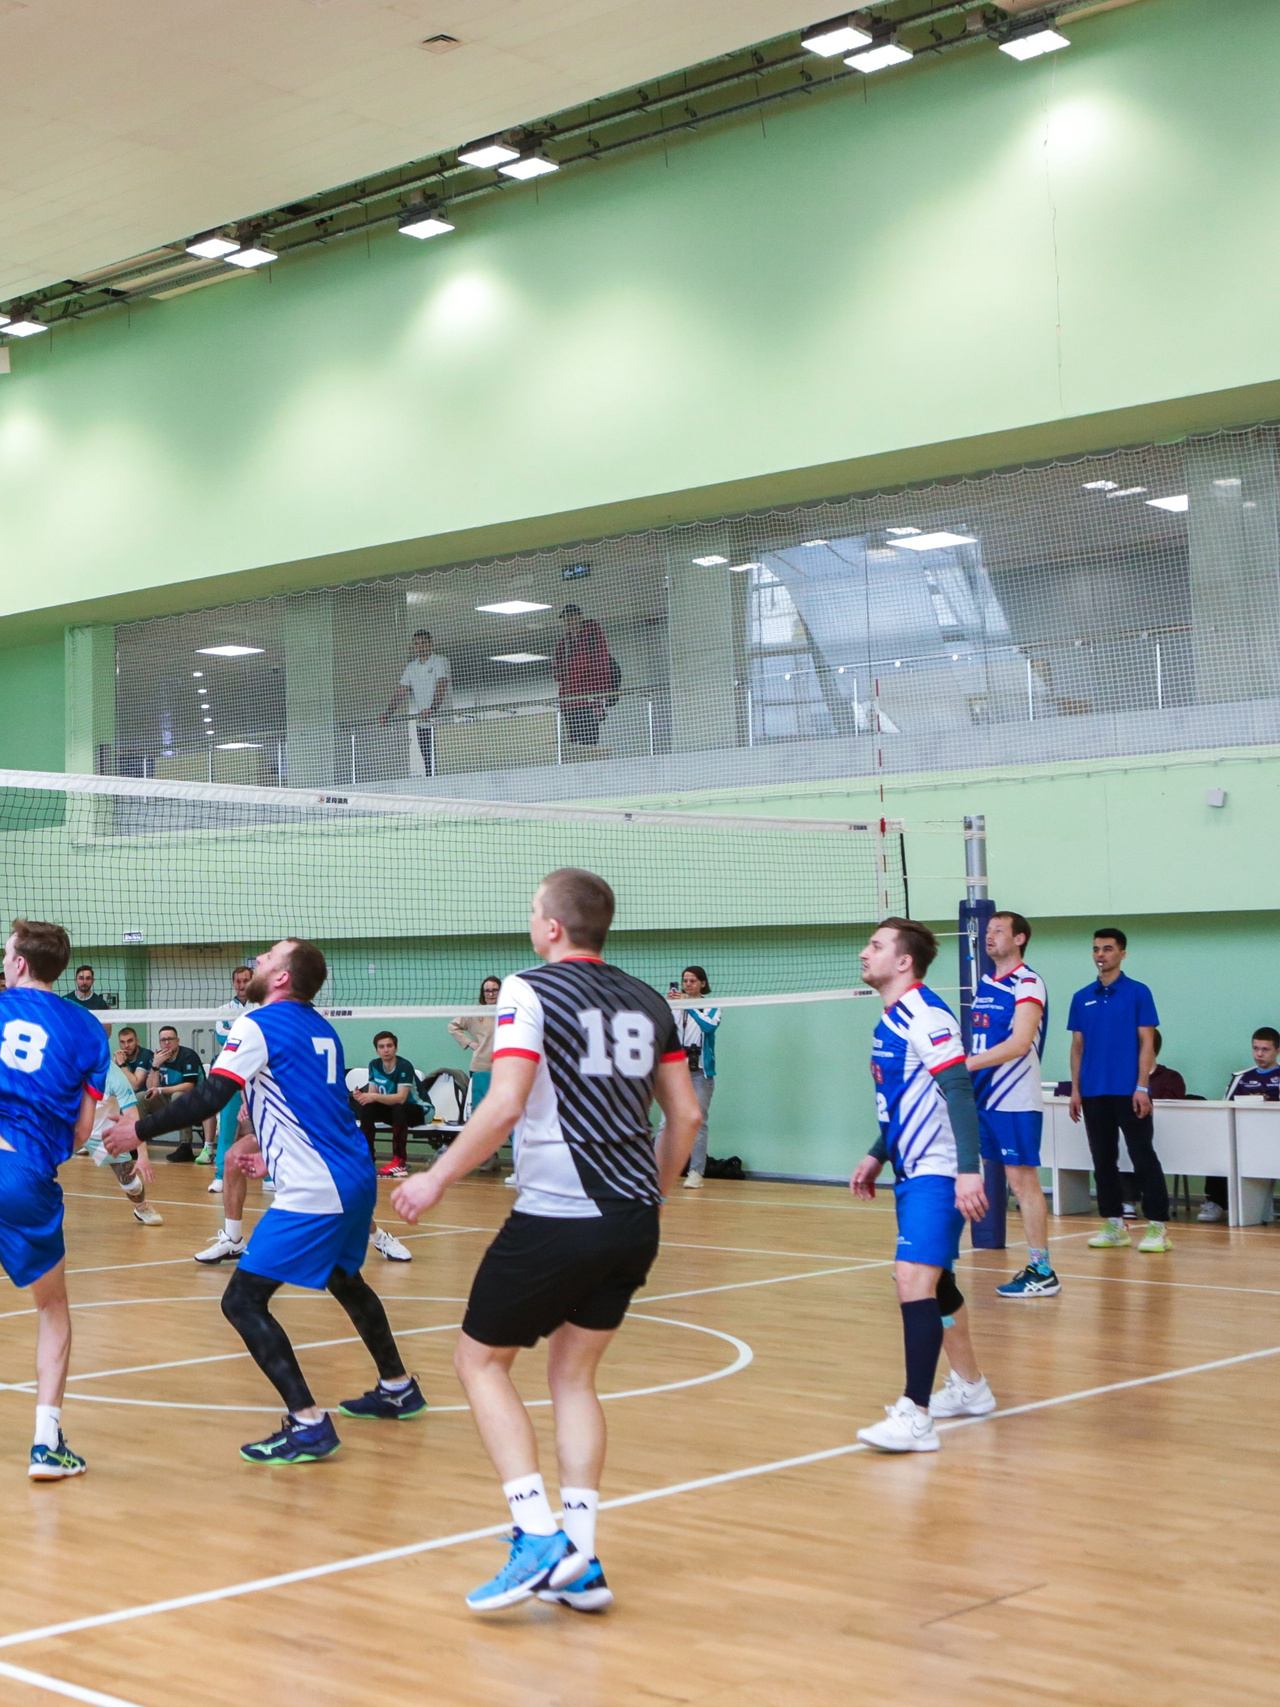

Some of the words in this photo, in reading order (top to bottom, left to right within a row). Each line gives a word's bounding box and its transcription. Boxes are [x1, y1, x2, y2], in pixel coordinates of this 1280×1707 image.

[0, 1018, 50, 1074] 8
[311, 1036, 337, 1084] 7
[577, 1008, 655, 1078] 18
[972, 1033, 989, 1055] 11
[563, 1501, 589, 1510] ILA
